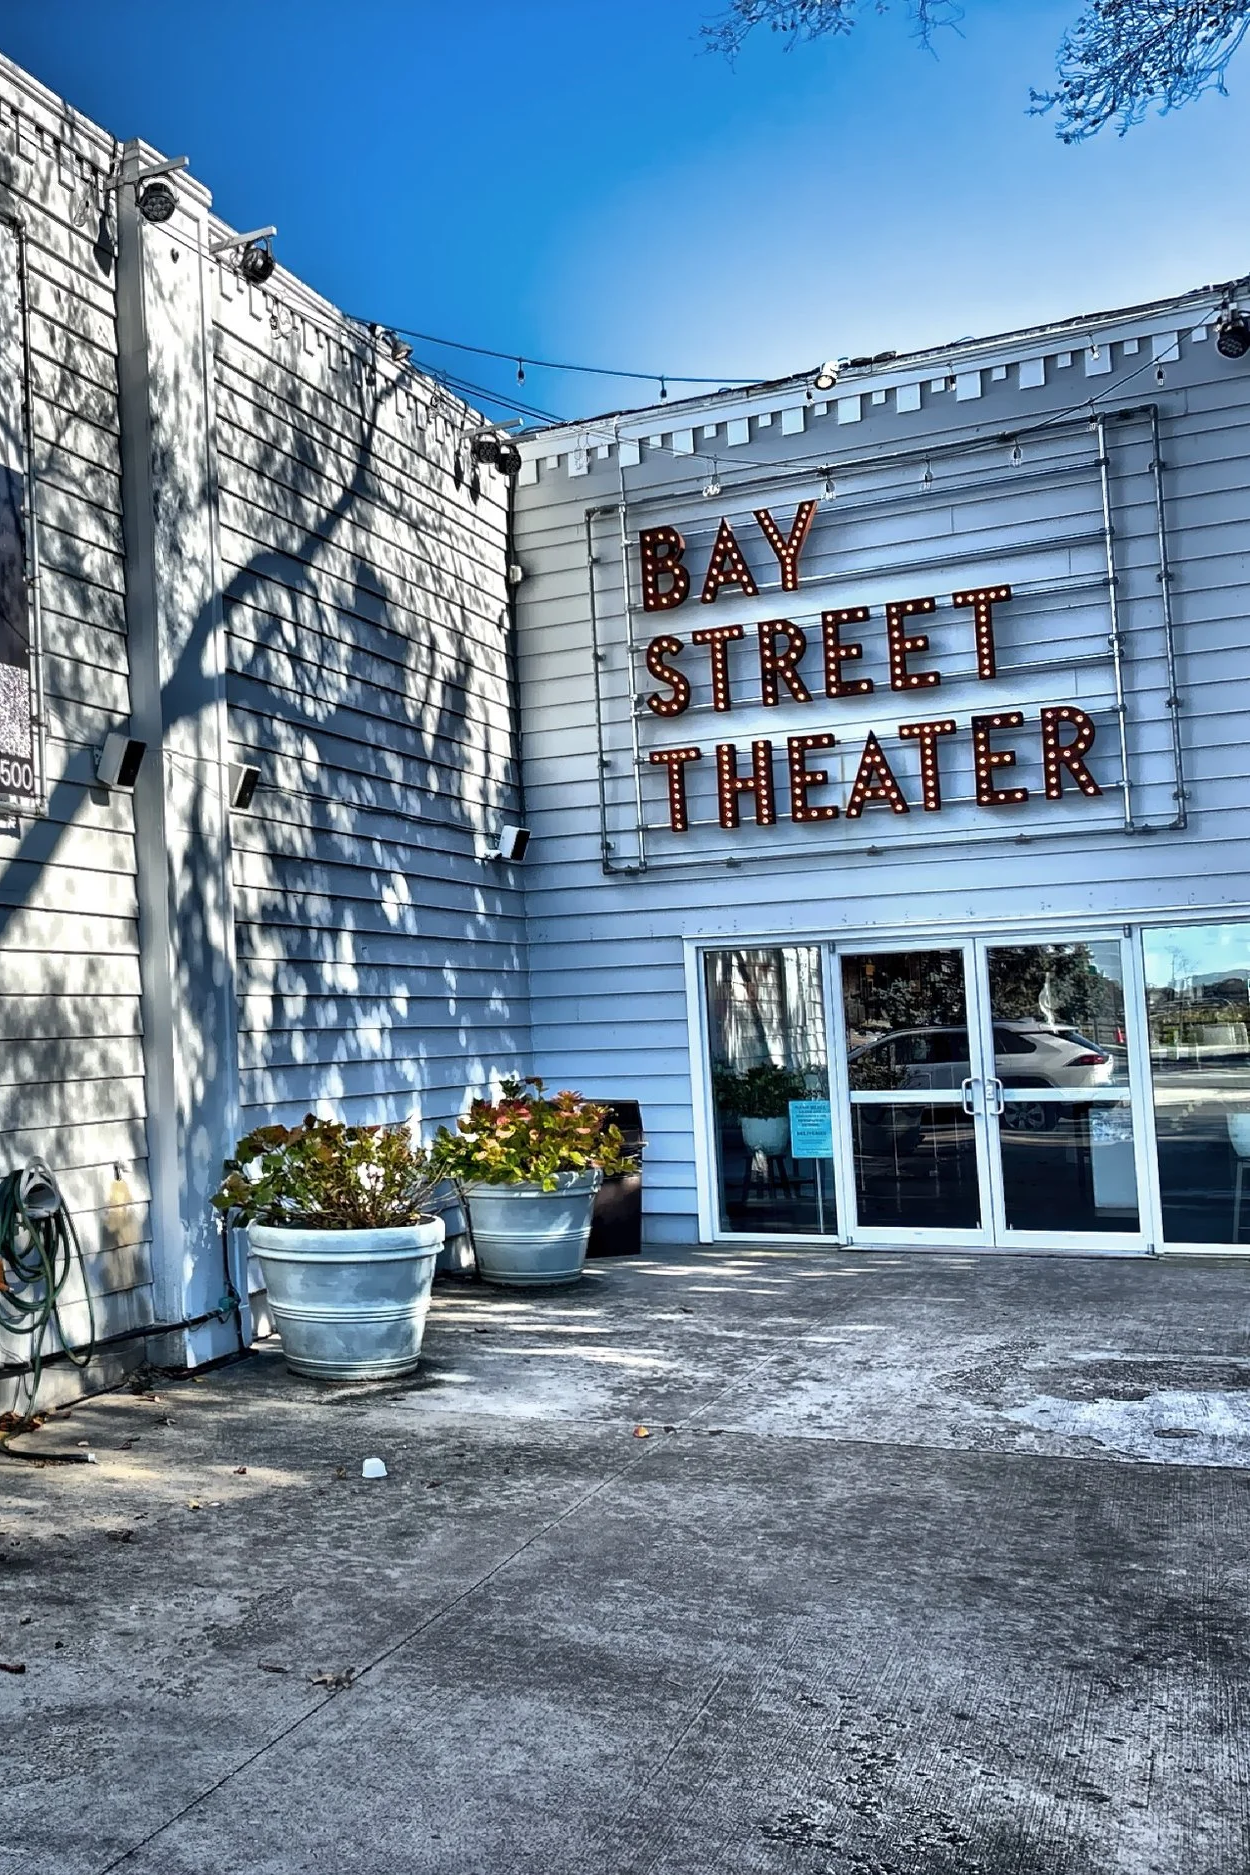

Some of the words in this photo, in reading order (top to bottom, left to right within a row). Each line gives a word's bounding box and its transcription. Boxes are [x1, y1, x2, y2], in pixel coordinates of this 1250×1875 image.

[639, 500, 818, 613] BAY
[646, 583, 1012, 718] STREET
[649, 706, 1103, 833] THEATER
